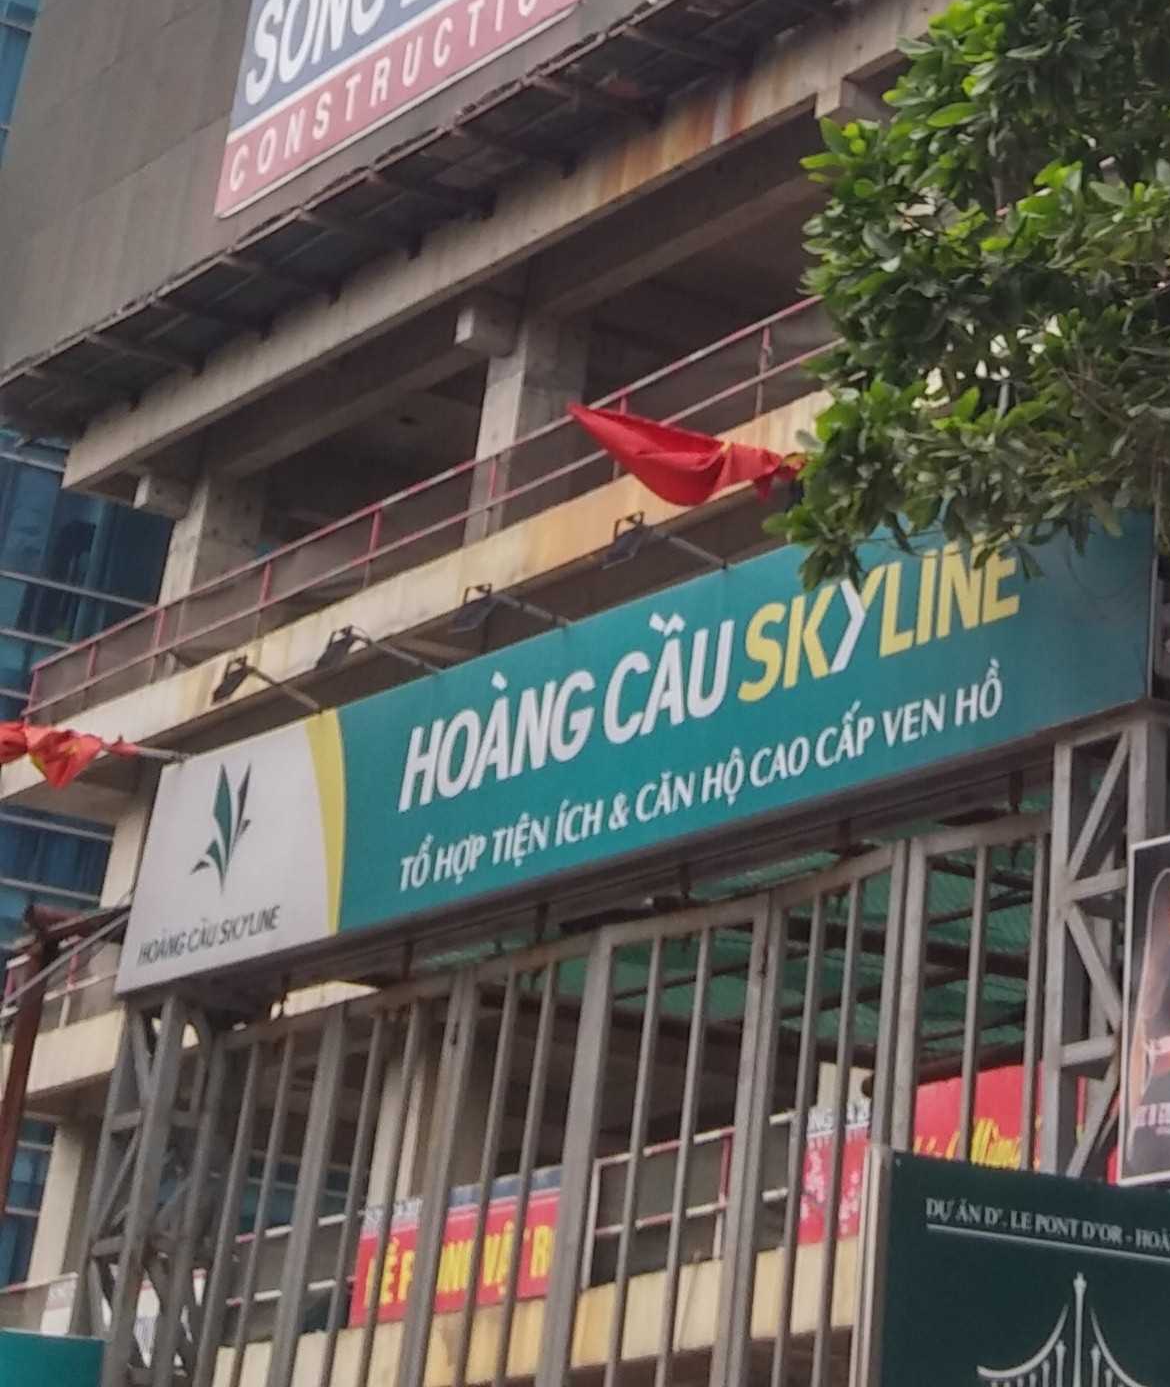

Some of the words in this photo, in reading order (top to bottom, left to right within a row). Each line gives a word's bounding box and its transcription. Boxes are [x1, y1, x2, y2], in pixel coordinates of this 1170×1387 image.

[398, 668, 597, 813] HOÀNG
[603, 612, 735, 745] CẦU
[737, 526, 1022, 703] SKYLINE
[400, 833, 434, 892] TỔ
[434, 833, 488, 885] HỢP
[492, 811, 551, 868] TIỆN
[554, 797, 605, 848] ÍCH
[608, 791, 631, 831] &
[634, 770, 697, 824] CĂN
[701, 745, 746, 806] HỘ
[749, 736, 810, 788] CAO
[814, 700, 876, 769] CẤP
[881, 693, 947, 748] VEN
[954, 657, 1003, 727] HỒ
[218, 904, 281, 945] SKYLINE
[1010, 1210, 1033, 1230] LE
[1034, 1213, 1080, 1239] PONT
[1081, 1220, 1123, 1245] D'OR
